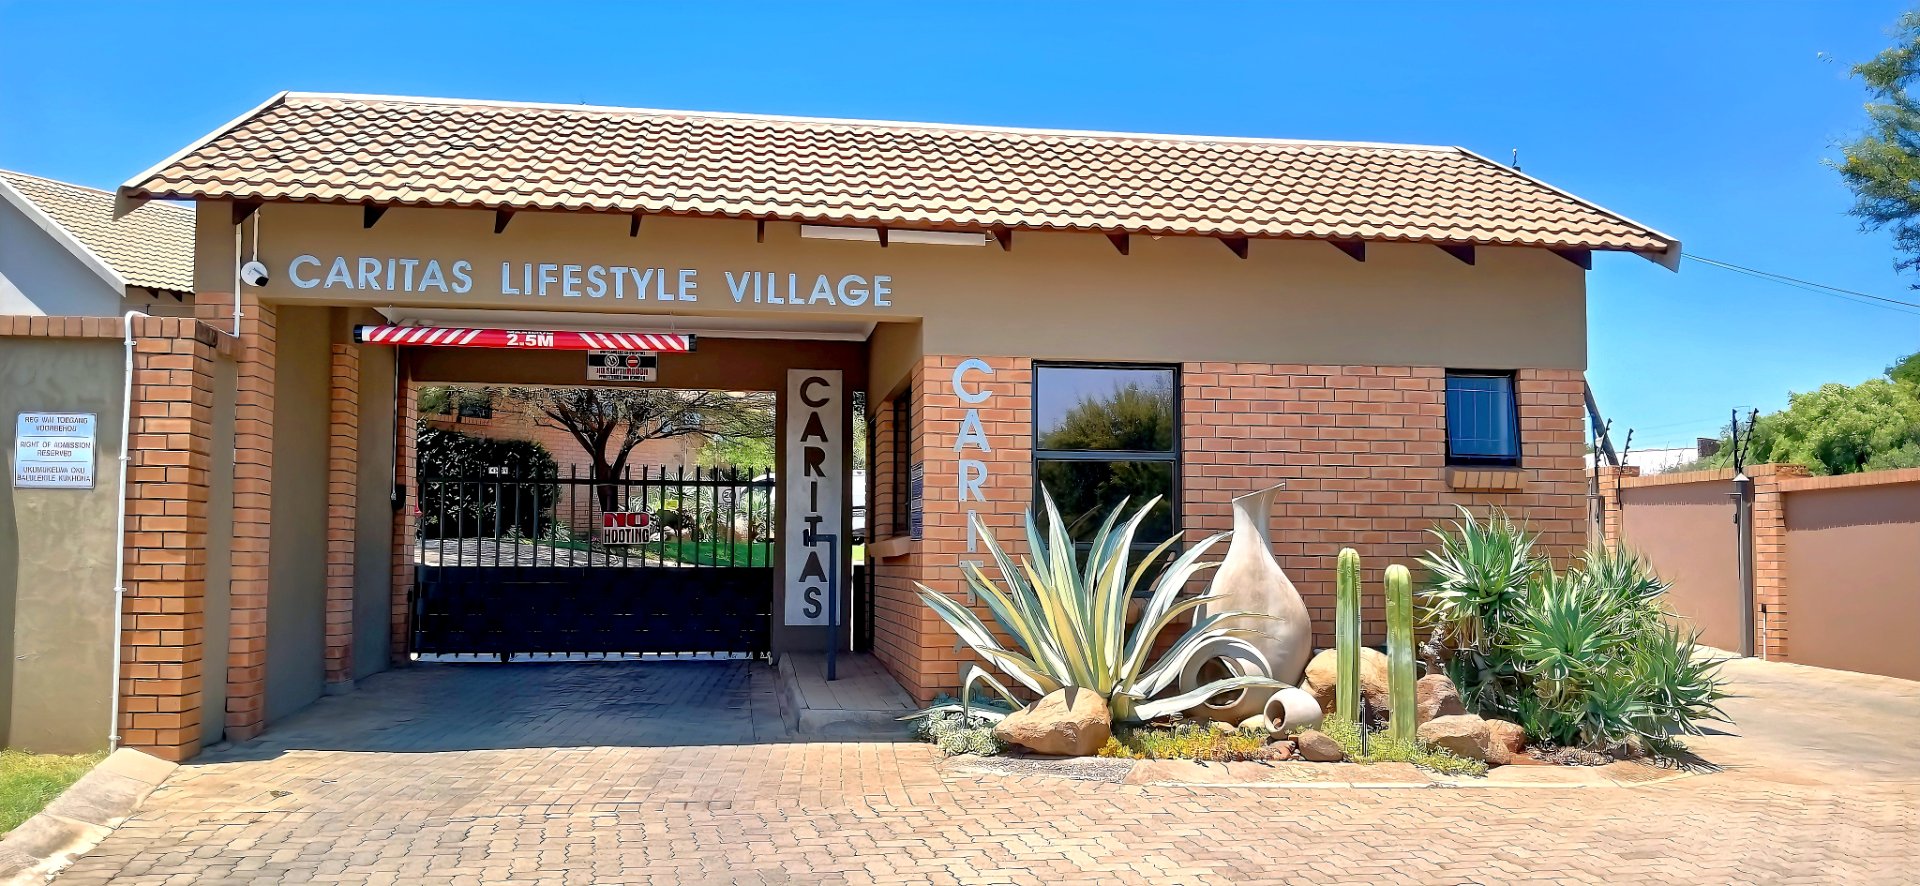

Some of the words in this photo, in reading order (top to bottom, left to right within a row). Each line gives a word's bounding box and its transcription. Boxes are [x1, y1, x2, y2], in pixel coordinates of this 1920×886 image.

[288, 254, 473, 294] CARITAS
[502, 262, 698, 302] LIFESTYLE
[724, 271, 893, 307] VILLAGE
[506, 333, 554, 347] 2.5M
[53, 441, 91, 449] ADMISSION
[37, 449, 72, 457] RESERVED
[798, 376, 831, 619] CARITAS
[603, 512, 650, 527] NO
[951, 358, 994, 697] CARIT
[604, 528, 649, 543] HOOTING
